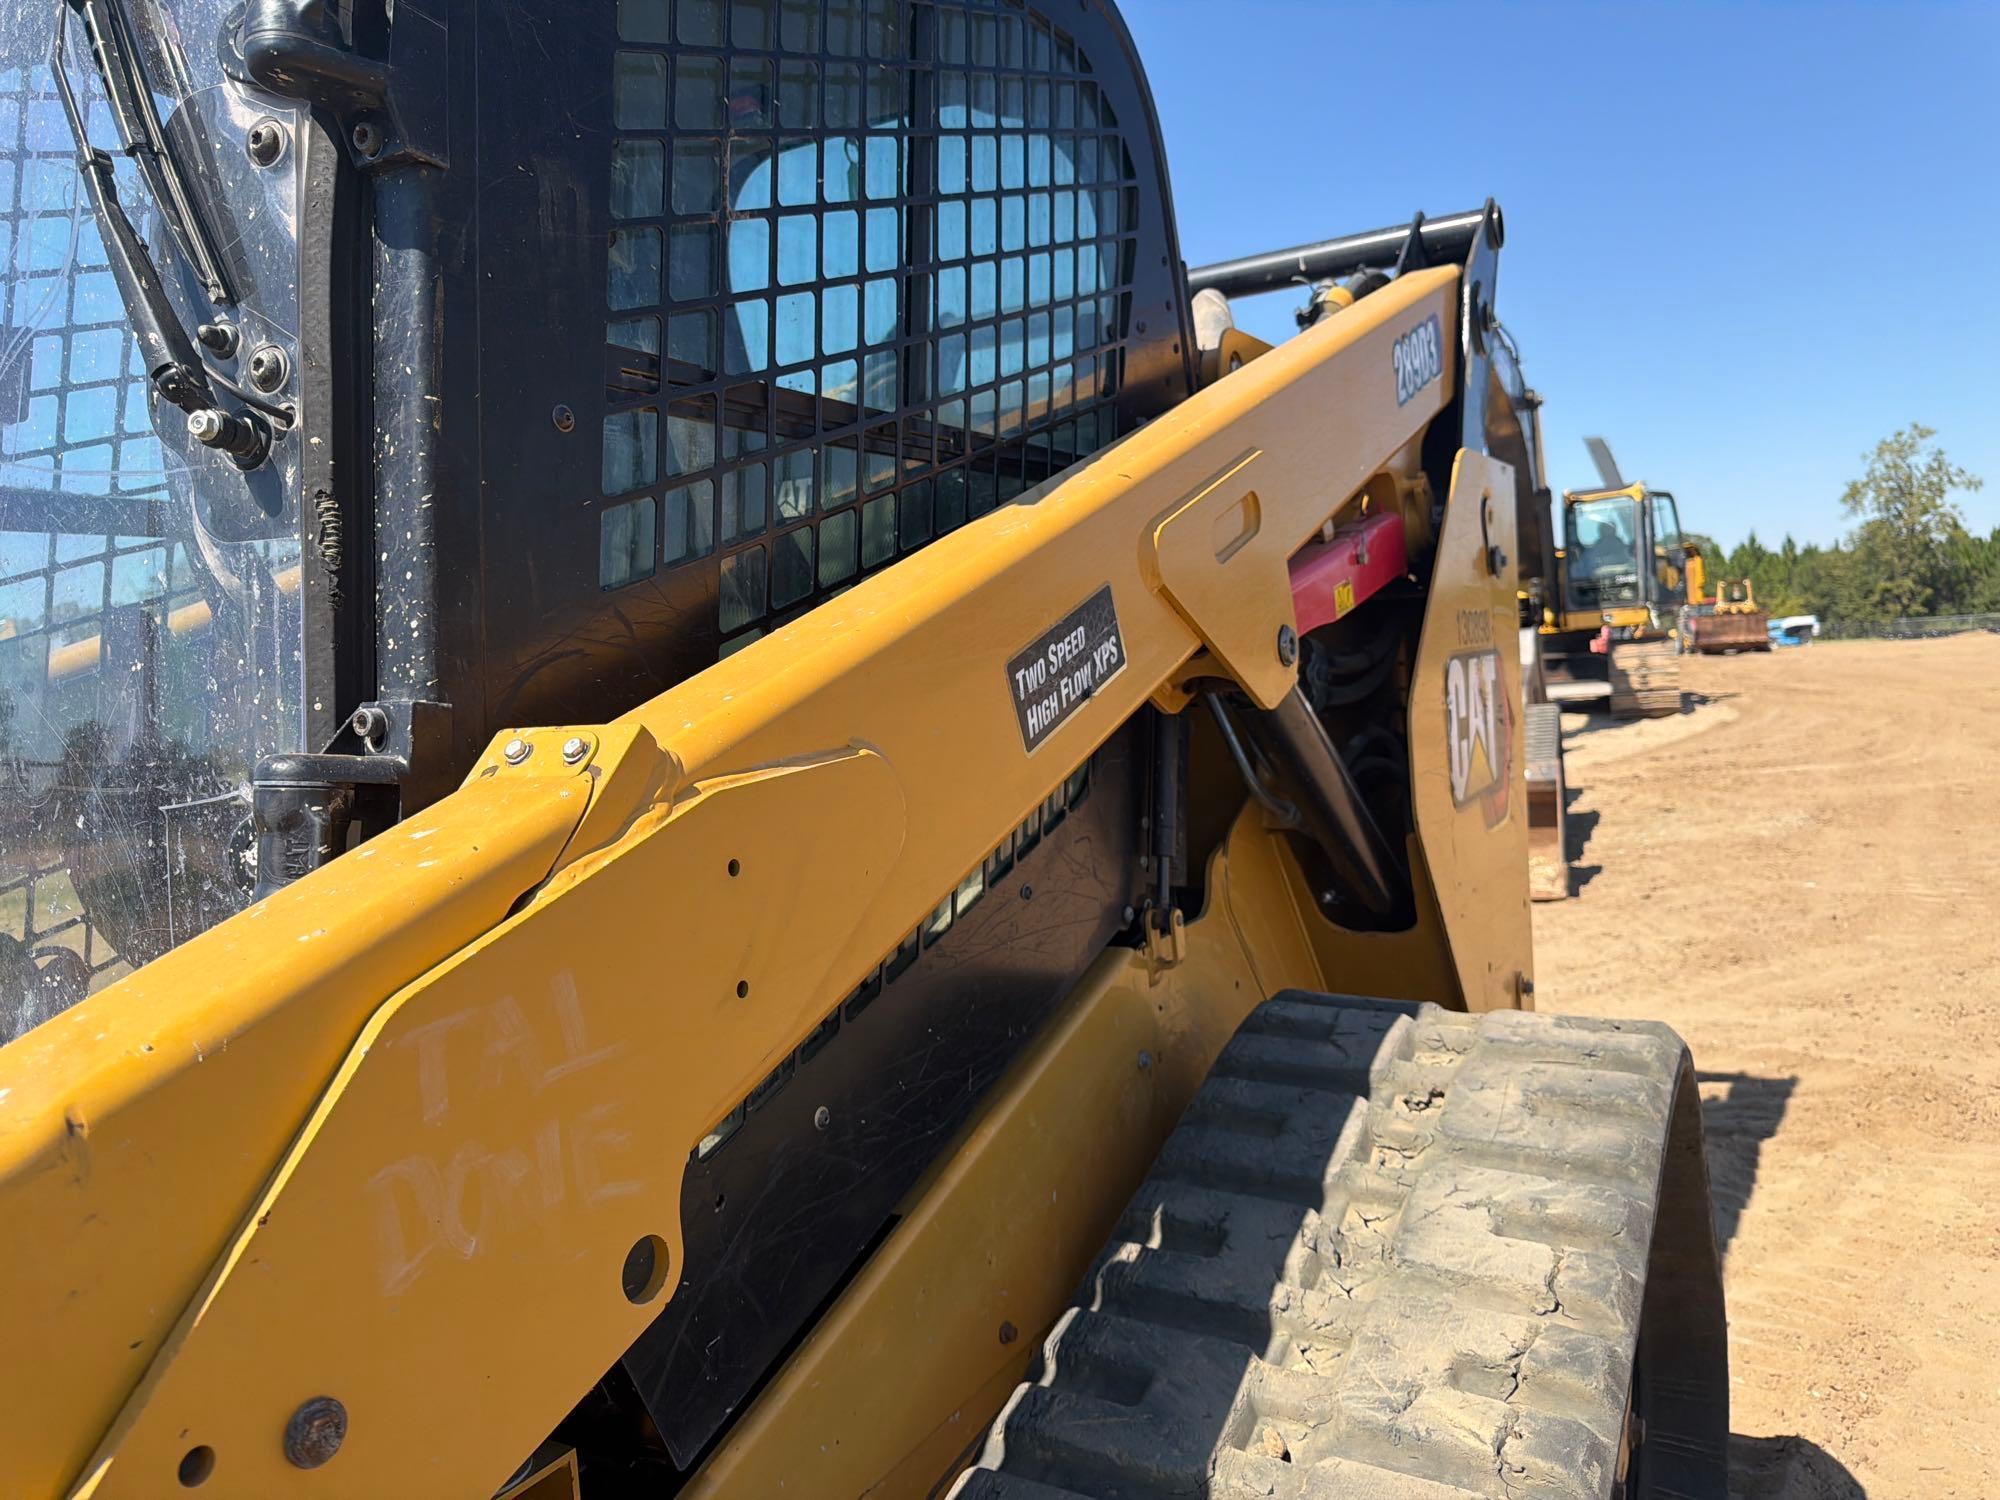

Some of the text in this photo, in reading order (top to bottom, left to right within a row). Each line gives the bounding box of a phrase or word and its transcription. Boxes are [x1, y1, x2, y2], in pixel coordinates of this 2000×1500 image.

[1015, 625, 1086, 701] TWO SPEED
[1026, 634, 1118, 740] HIGH FLOW XPS
[1447, 655, 1497, 801] CAT
